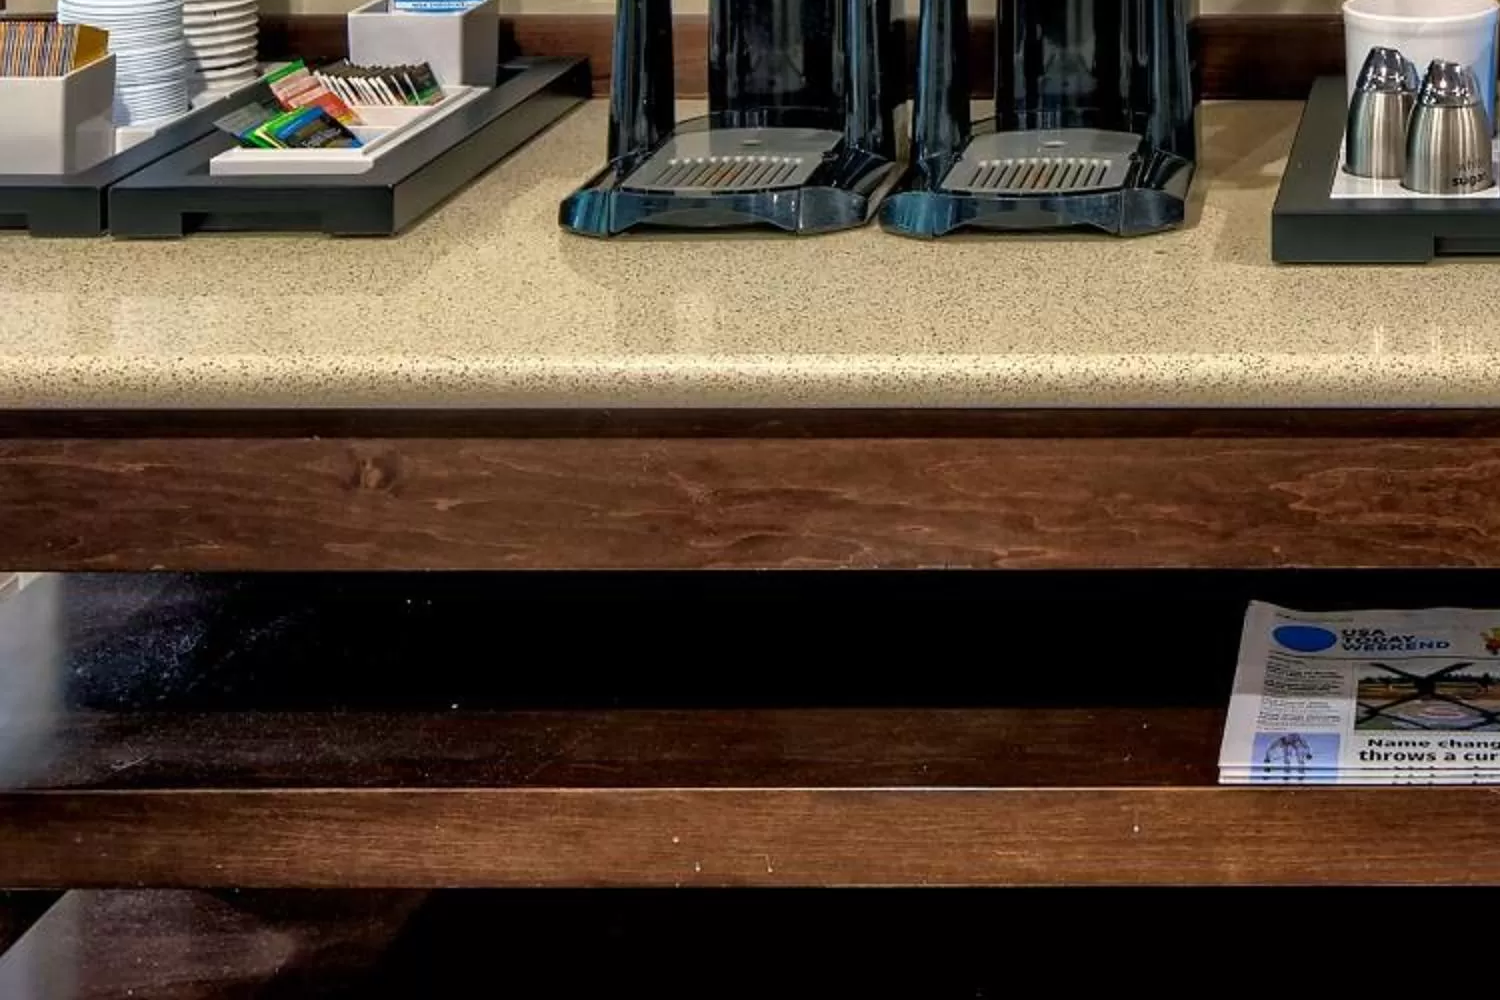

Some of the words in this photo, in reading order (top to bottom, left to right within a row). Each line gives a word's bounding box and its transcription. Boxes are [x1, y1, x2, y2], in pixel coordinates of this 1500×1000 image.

[1341, 629, 1386, 637] USA
[1341, 641, 1451, 652] WEEKEND
[1367, 738, 1432, 749] Name
[1359, 749, 1437, 762] throws
[1443, 751, 1457, 762] a
